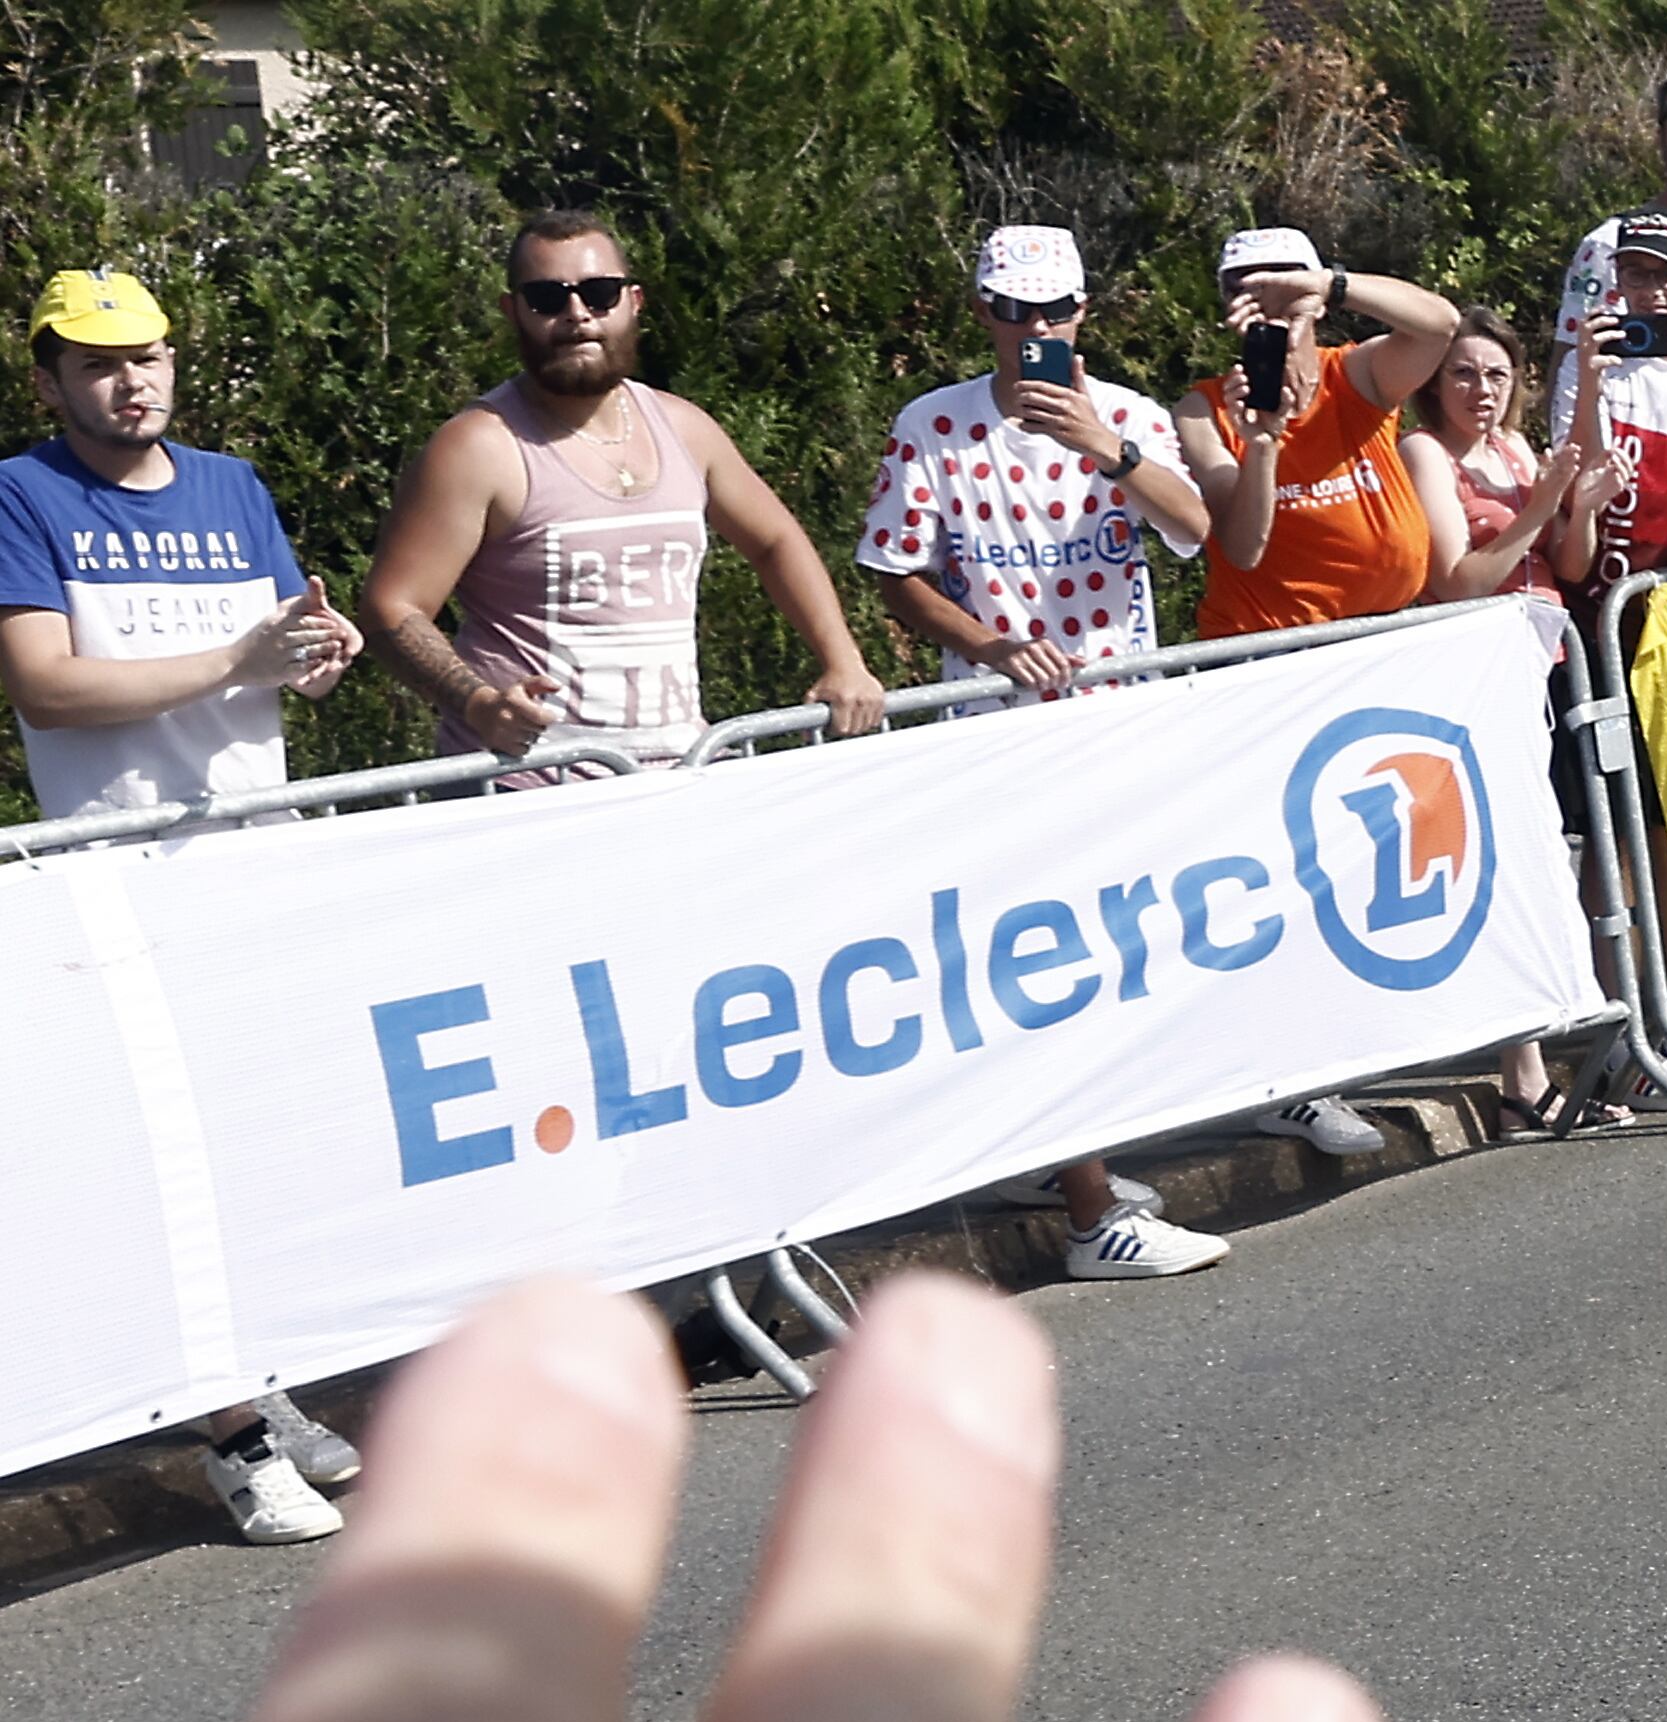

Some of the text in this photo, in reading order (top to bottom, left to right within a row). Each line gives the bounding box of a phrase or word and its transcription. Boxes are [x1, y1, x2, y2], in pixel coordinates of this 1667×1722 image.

[73, 531, 250, 570] KAPORAL
[568, 541, 693, 611] BER
[118, 598, 234, 634] JEANS
[370, 855, 1286, 1188] E.Leclerc
